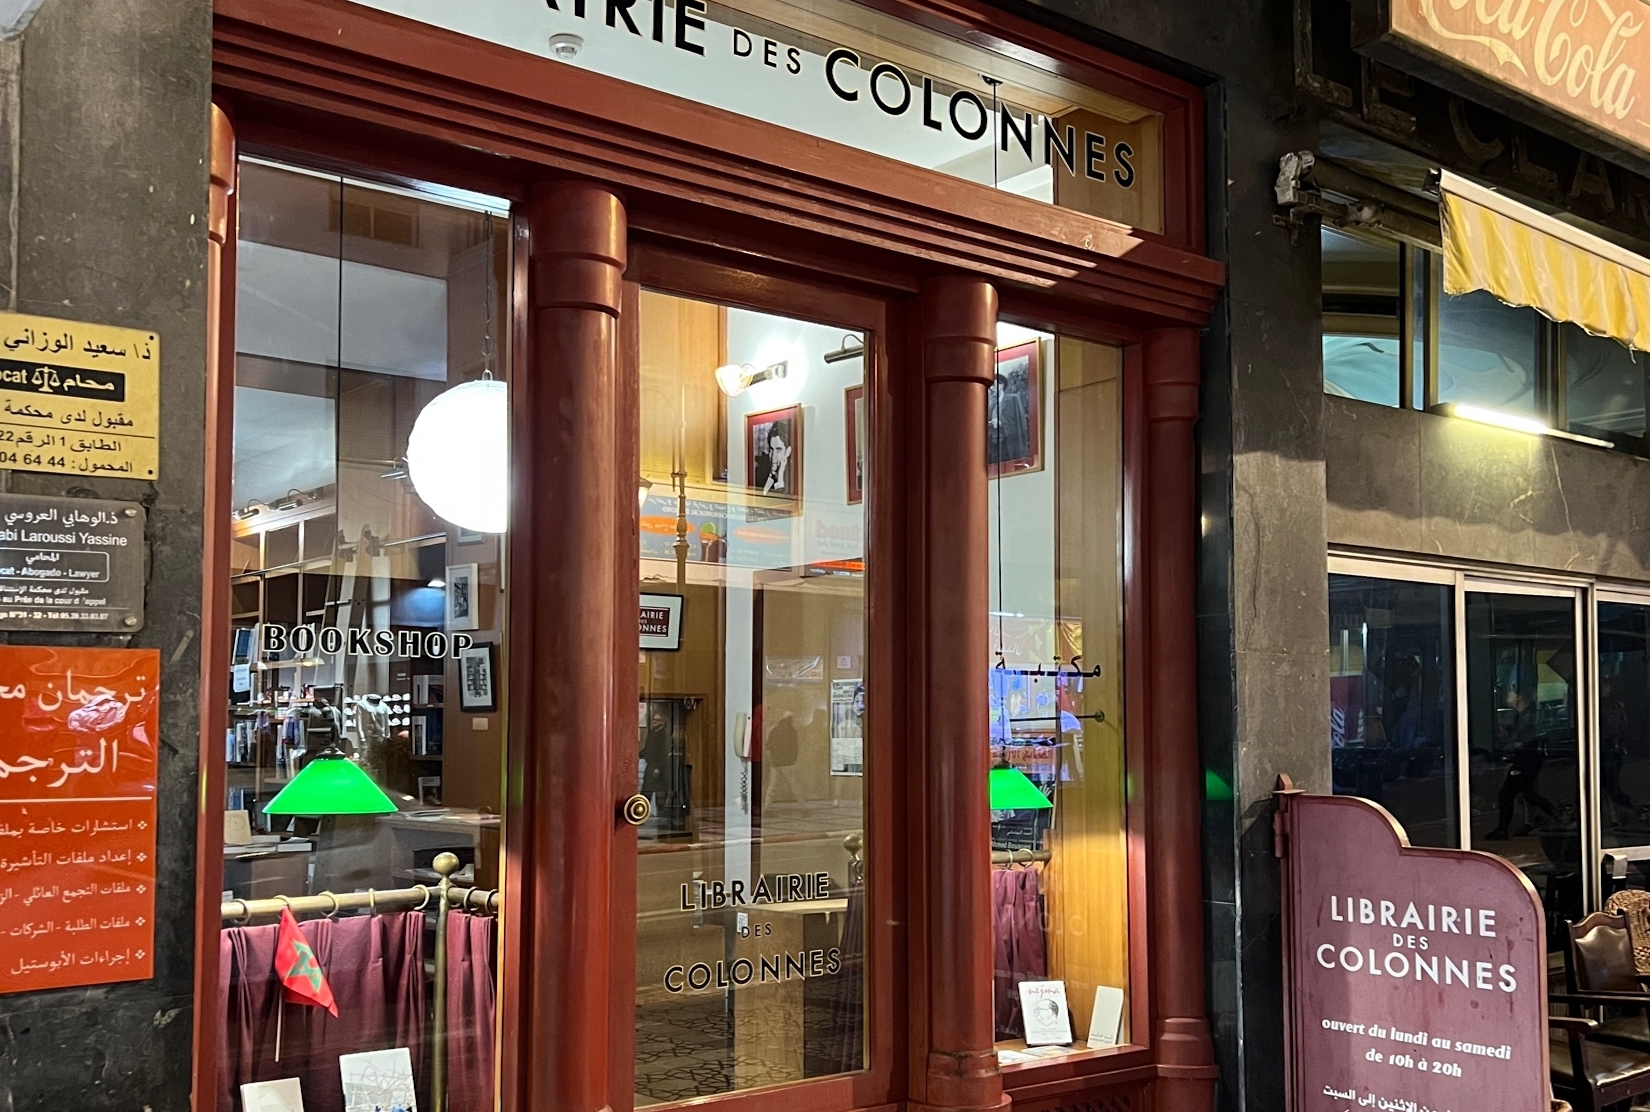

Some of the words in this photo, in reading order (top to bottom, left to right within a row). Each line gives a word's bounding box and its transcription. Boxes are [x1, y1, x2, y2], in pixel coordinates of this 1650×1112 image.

[732, 27, 802, 75] DES
[825, 48, 1136, 190] COLONNES
[4, 328, 74, 354] الوزاني
[83, 340, 127, 358] سعيد
[0, 369, 28, 384] cat
[63, 374, 116, 391] محام
[4, 399, 53, 419] محكمة
[60, 409, 87, 424] لدى
[92, 411, 134, 429] مقبول
[60, 436, 66, 446] 1
[23, 453, 42, 465] 64
[47, 456, 66, 467] 44
[4, 508, 58, 525] العروسي
[21, 530, 76, 544] Laroussi
[79, 532, 128, 546] Yassine
[21, 567, 61, 578] Abogado
[69, 569, 100, 579] Lawyer
[261, 624, 474, 660] BOOKSHOP
[28, 821, 67, 834] خاصة
[71, 819, 133, 836] استشارات
[0, 850, 52, 872] التأشيرة
[56, 851, 95, 865] ملفات
[99, 849, 132, 865] إعداد
[23, 885, 59, 906] العائلي
[62, 883, 98, 903] التجمع
[680, 872, 830, 912] LIBRAIRIE
[100, 916, 130, 929] ملفات
[1331, 895, 1497, 938] LIBRAIRIE
[10, 921, 54, 939] الشركات
[65, 918, 97, 934] الطلبة
[741, 923, 773, 939] DES
[1392, 933, 1429, 950] DES
[11, 951, 75, 975] الأبوستيل
[80, 948, 130, 966] إجراءات
[663, 948, 842, 994] COLONNES
[1316, 943, 1518, 993] COLONNES
[1321, 1018, 1366, 1035] ouvert
[1368, 1024, 1387, 1039] du
[1390, 1027, 1429, 1046] lundi
[1431, 1037, 1451, 1050] au
[1454, 1041, 1512, 1060] samedi
[1365, 1048, 1383, 1063] de
[1388, 1052, 1414, 1069] 10h
[1418, 1056, 1428, 1071] à
[1432, 1061, 1462, 1078] 20h
[1322, 1085, 1356, 1101] السبت
[1358, 1093, 1376, 1107] إلى
